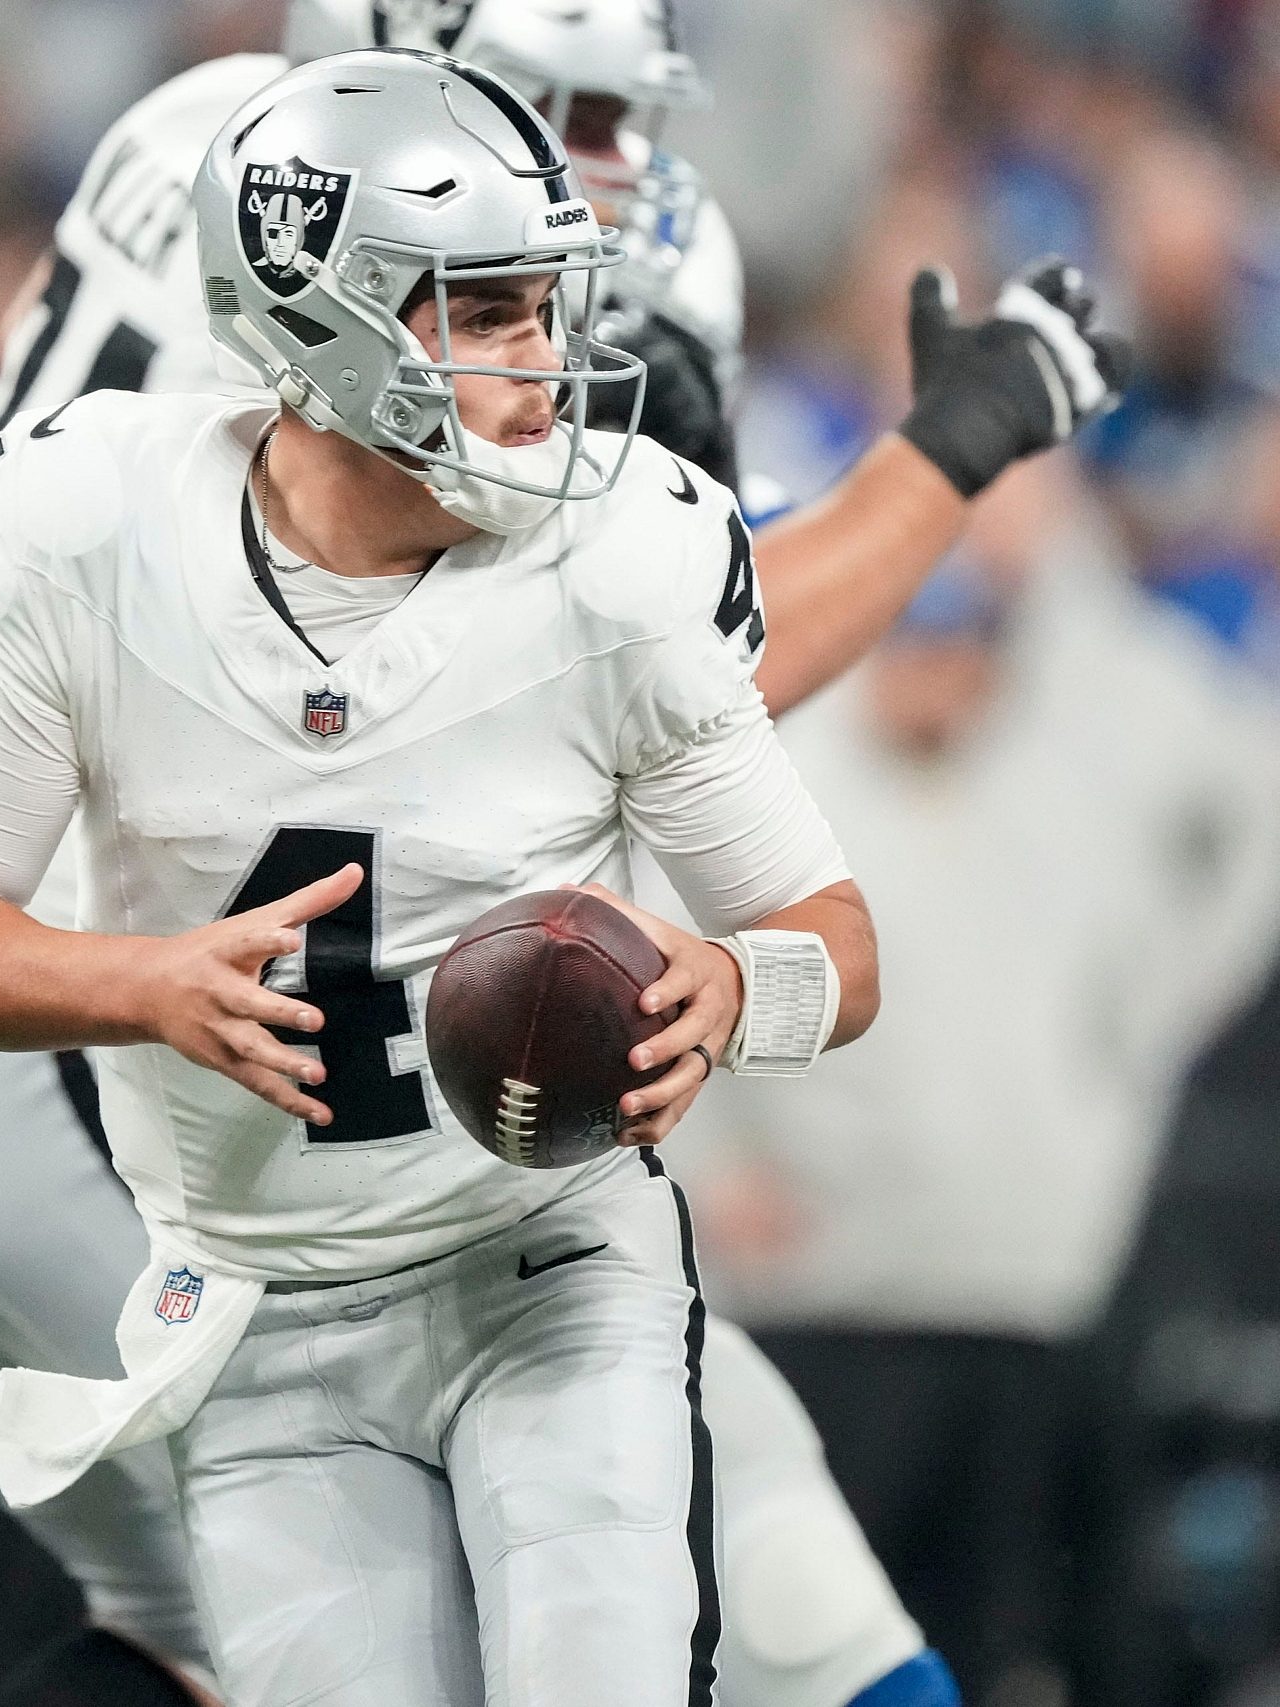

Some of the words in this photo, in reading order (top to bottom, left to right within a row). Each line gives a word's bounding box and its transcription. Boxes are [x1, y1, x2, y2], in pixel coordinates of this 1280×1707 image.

[249, 168, 340, 192] RAIDERS
[307, 710, 342, 733] NFL
[217, 823, 442, 1151] 4
[158, 1290, 193, 1320] NFL
